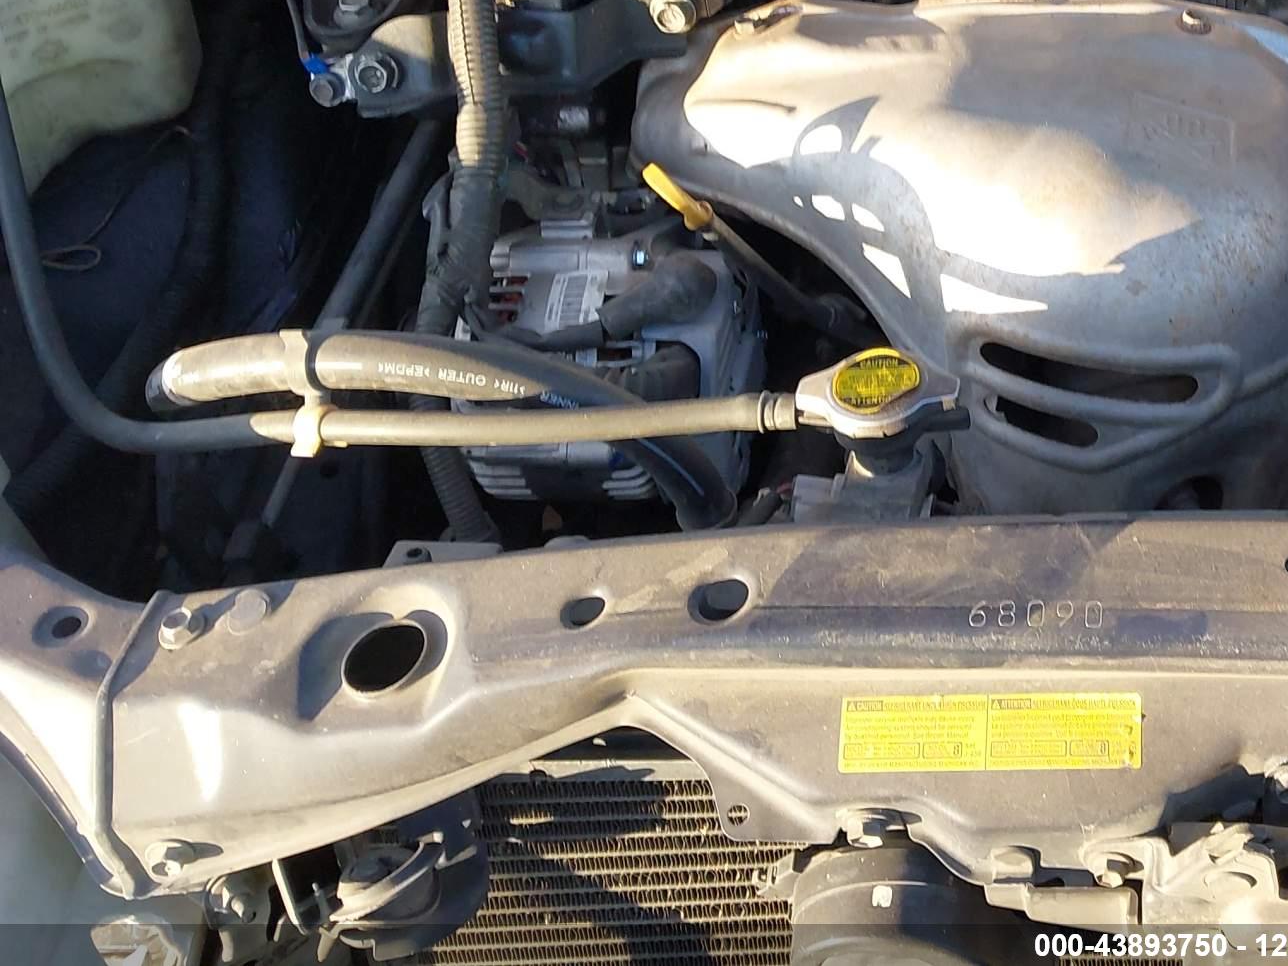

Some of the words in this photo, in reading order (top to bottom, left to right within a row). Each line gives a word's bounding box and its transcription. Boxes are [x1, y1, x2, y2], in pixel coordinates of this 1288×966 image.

[860, 357, 900, 369] CAUTION
[438, 367, 487, 386] OUTER
[968, 599, 1103, 628] 68090
